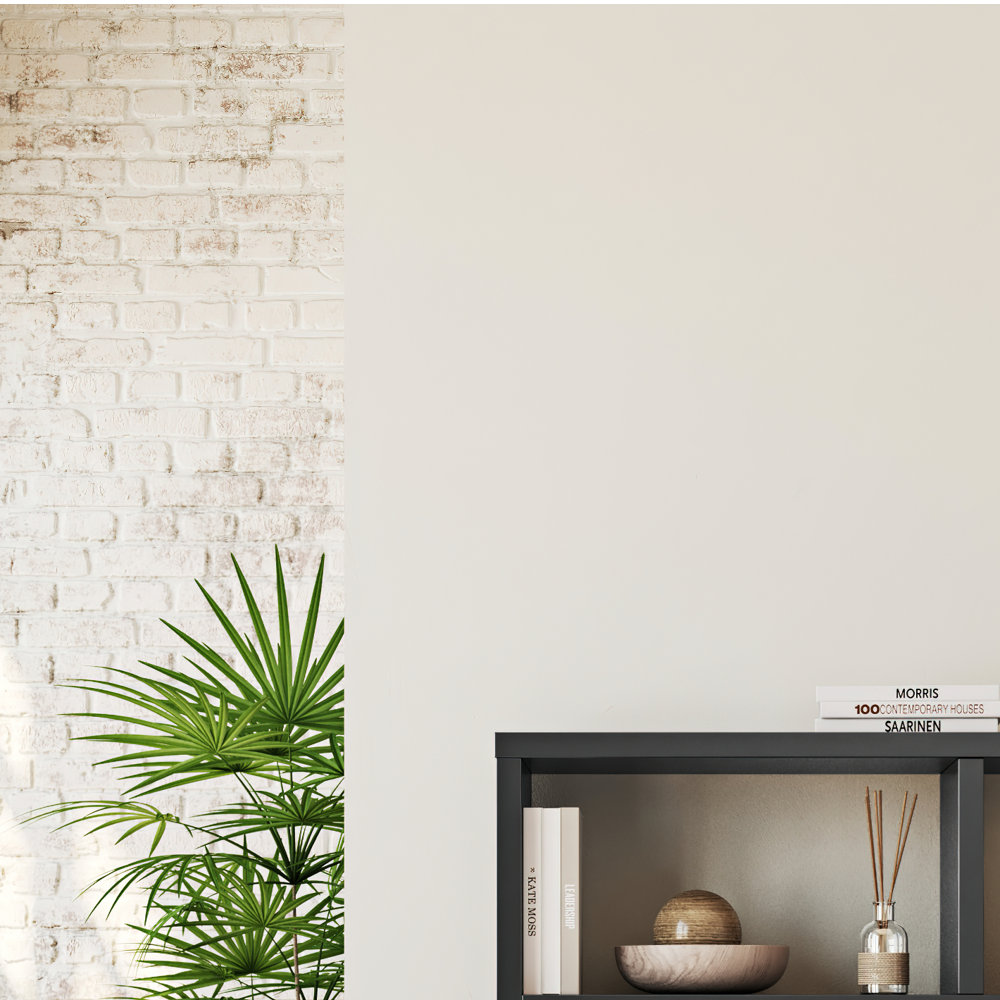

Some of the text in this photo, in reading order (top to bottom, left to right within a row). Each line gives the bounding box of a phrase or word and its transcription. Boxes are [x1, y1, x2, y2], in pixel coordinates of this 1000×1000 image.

[895, 688, 939, 699] MORRIS
[950, 704, 985, 714] HOUSES
[884, 720, 942, 732] SAARINEN
[527, 876, 537, 937] KATE MOSS
[564, 883, 576, 930] LEADERSHIP
